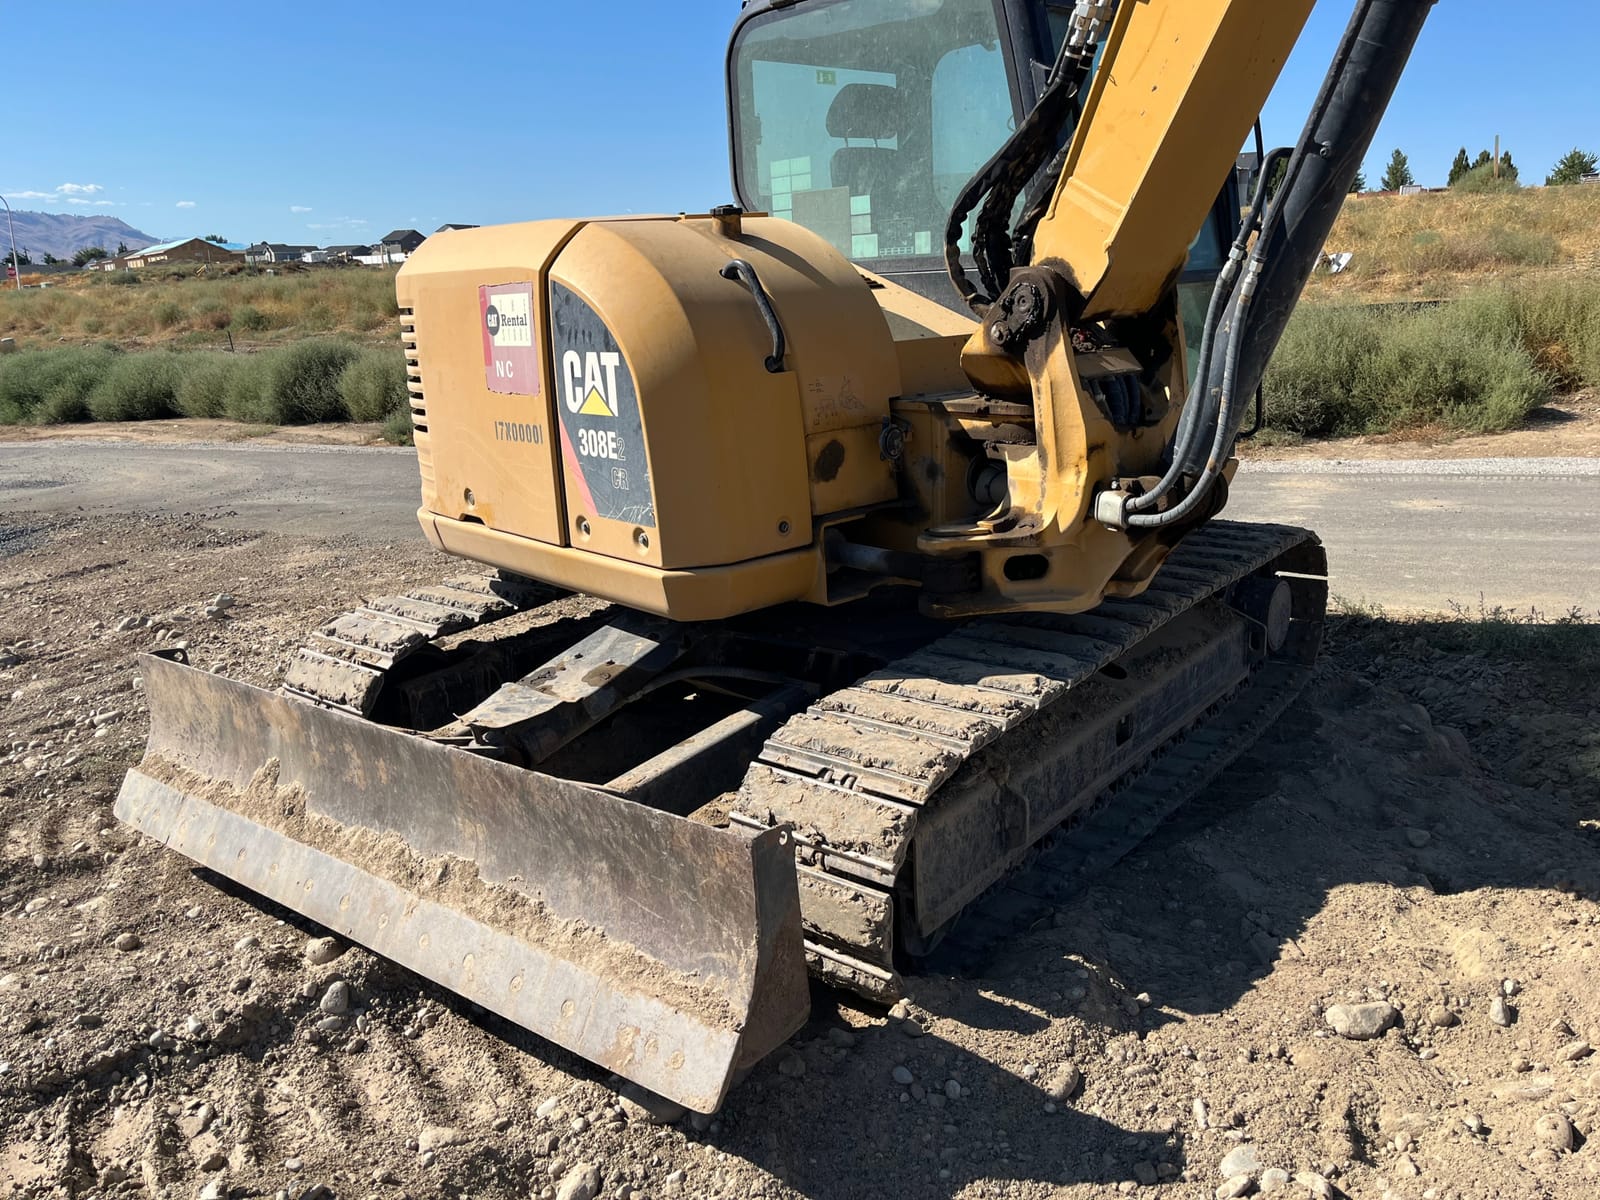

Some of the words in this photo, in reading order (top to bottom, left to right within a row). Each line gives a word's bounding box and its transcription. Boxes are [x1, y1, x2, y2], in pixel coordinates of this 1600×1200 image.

[487, 313, 498, 328] CAT
[500, 313, 527, 327] Rental
[495, 360, 514, 378] NC
[562, 350, 620, 417] CAT
[610, 466, 630, 491] CR
